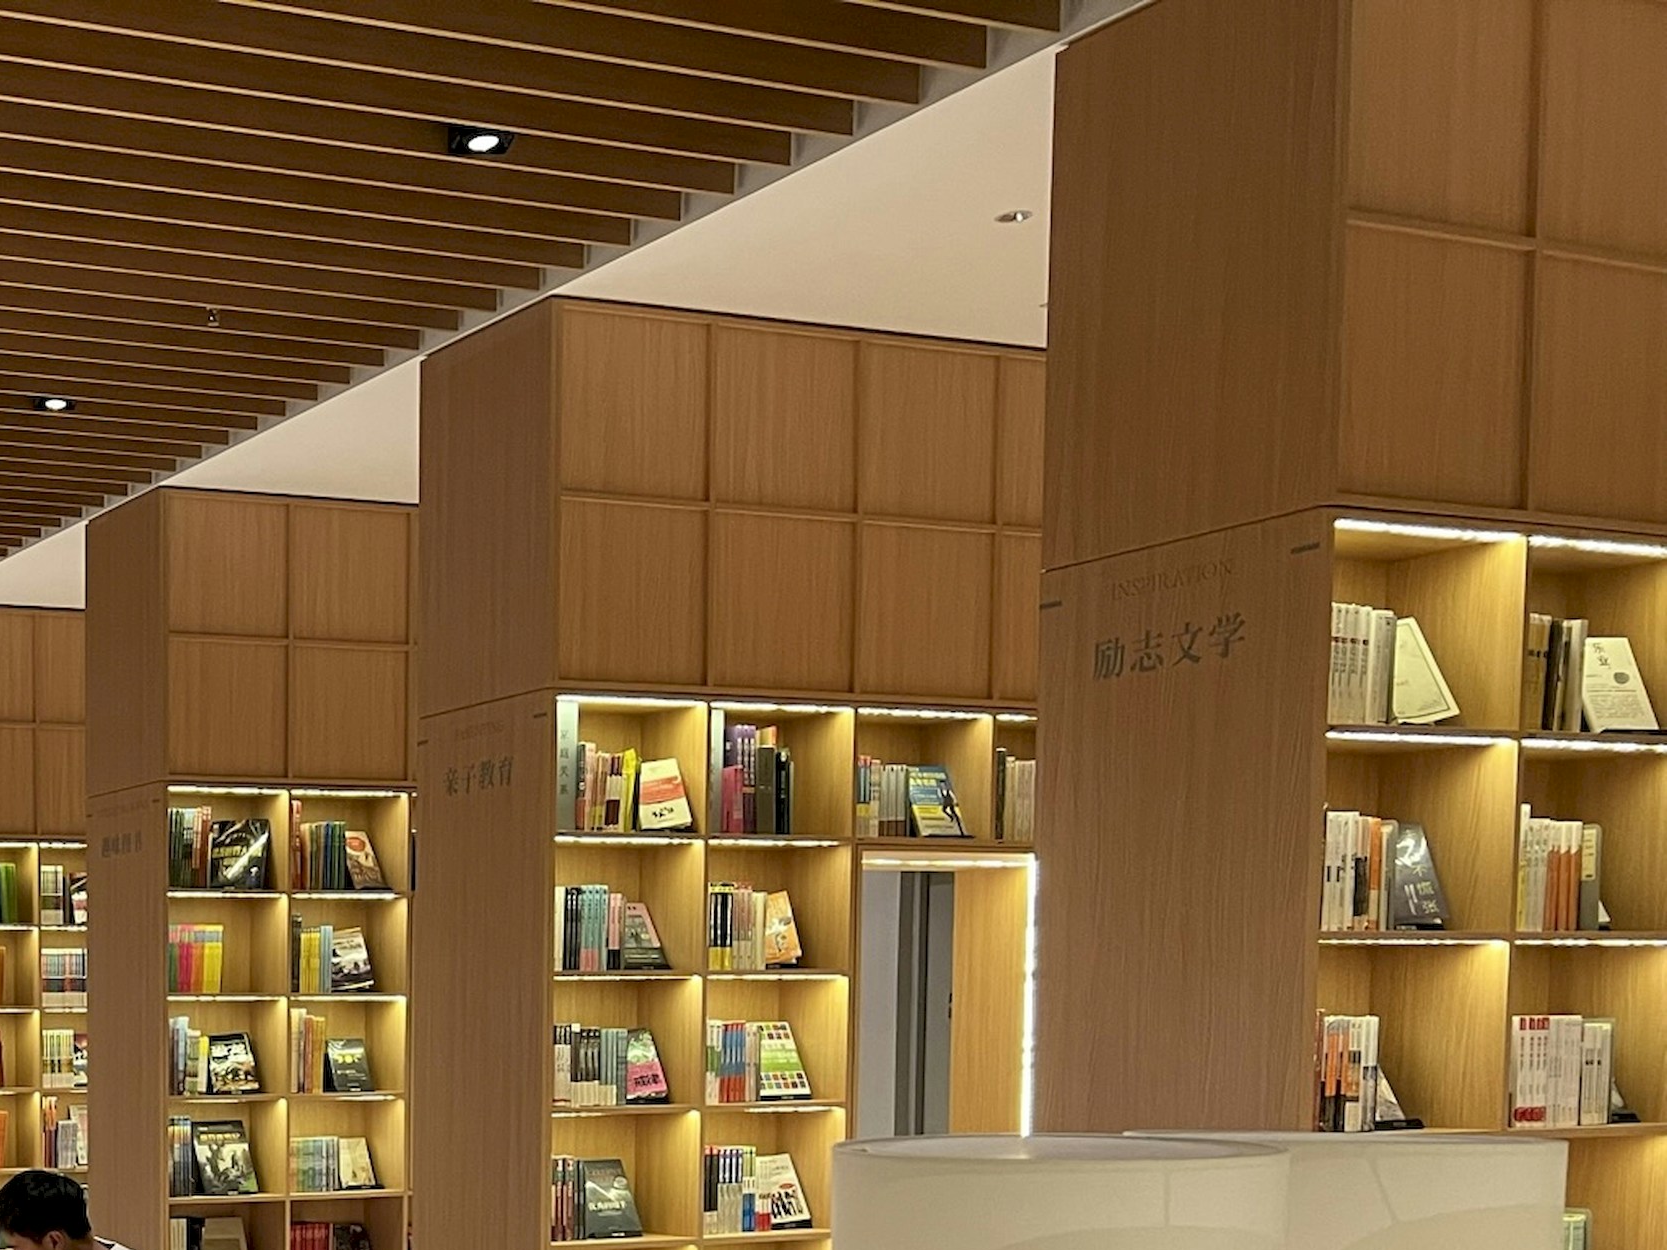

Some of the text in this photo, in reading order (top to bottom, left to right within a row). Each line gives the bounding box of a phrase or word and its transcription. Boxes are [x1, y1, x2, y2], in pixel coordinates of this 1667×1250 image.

[1093, 612, 1245, 681] 励志文学
[443, 756, 514, 796] 亲子教育
